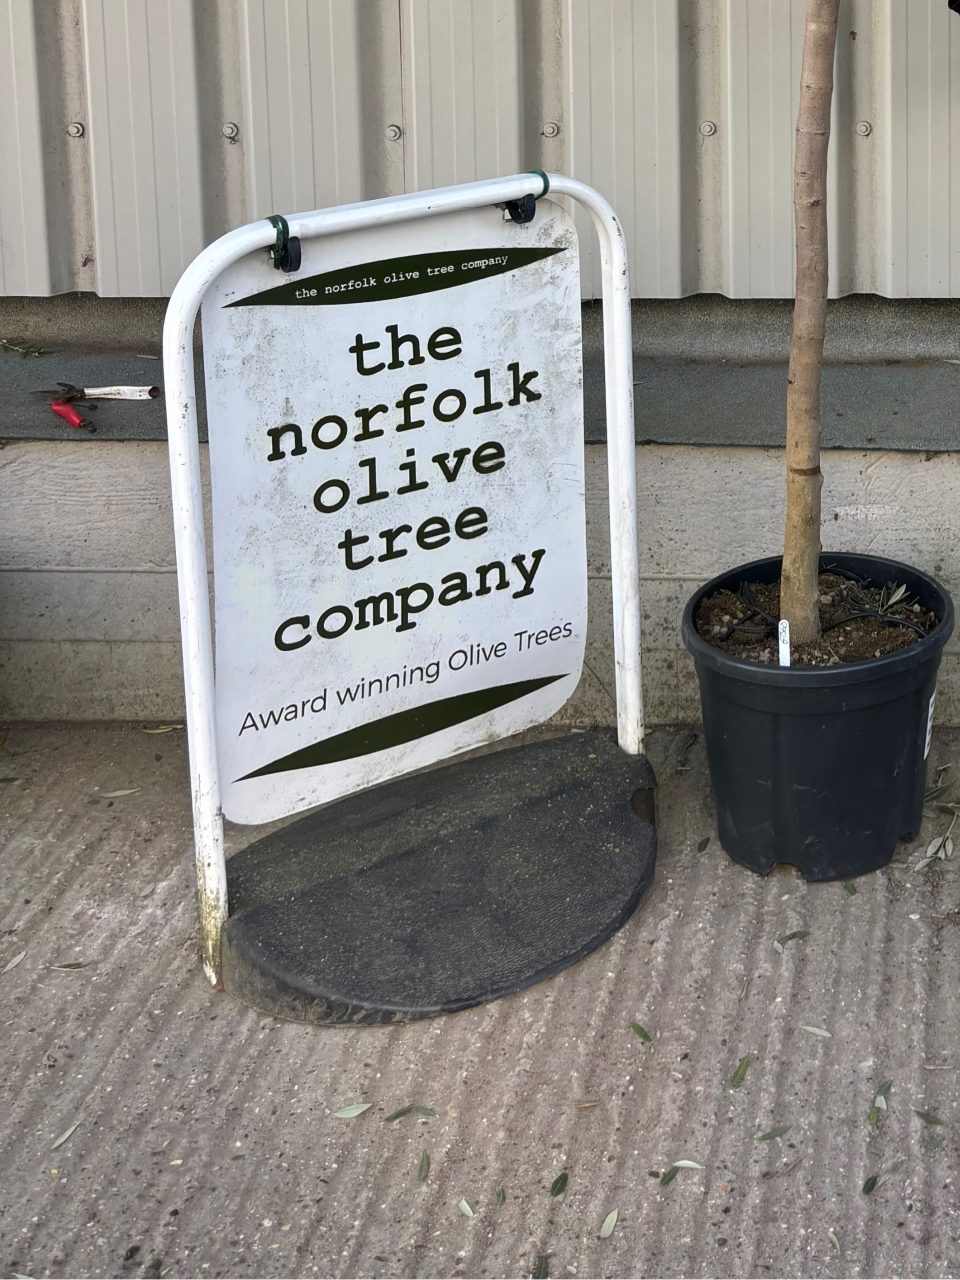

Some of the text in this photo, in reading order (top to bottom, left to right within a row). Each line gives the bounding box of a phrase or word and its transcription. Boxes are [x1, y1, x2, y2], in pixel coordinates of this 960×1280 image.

[295, 255, 509, 299] the norfolk olive tree company
[348, 324, 462, 376] the
[267, 362, 542, 462] norfolk
[313, 441, 506, 514] olive
[337, 506, 489, 571] tree
[274, 548, 546, 652] company
[238, 621, 573, 737] Award winning Olive Trees
